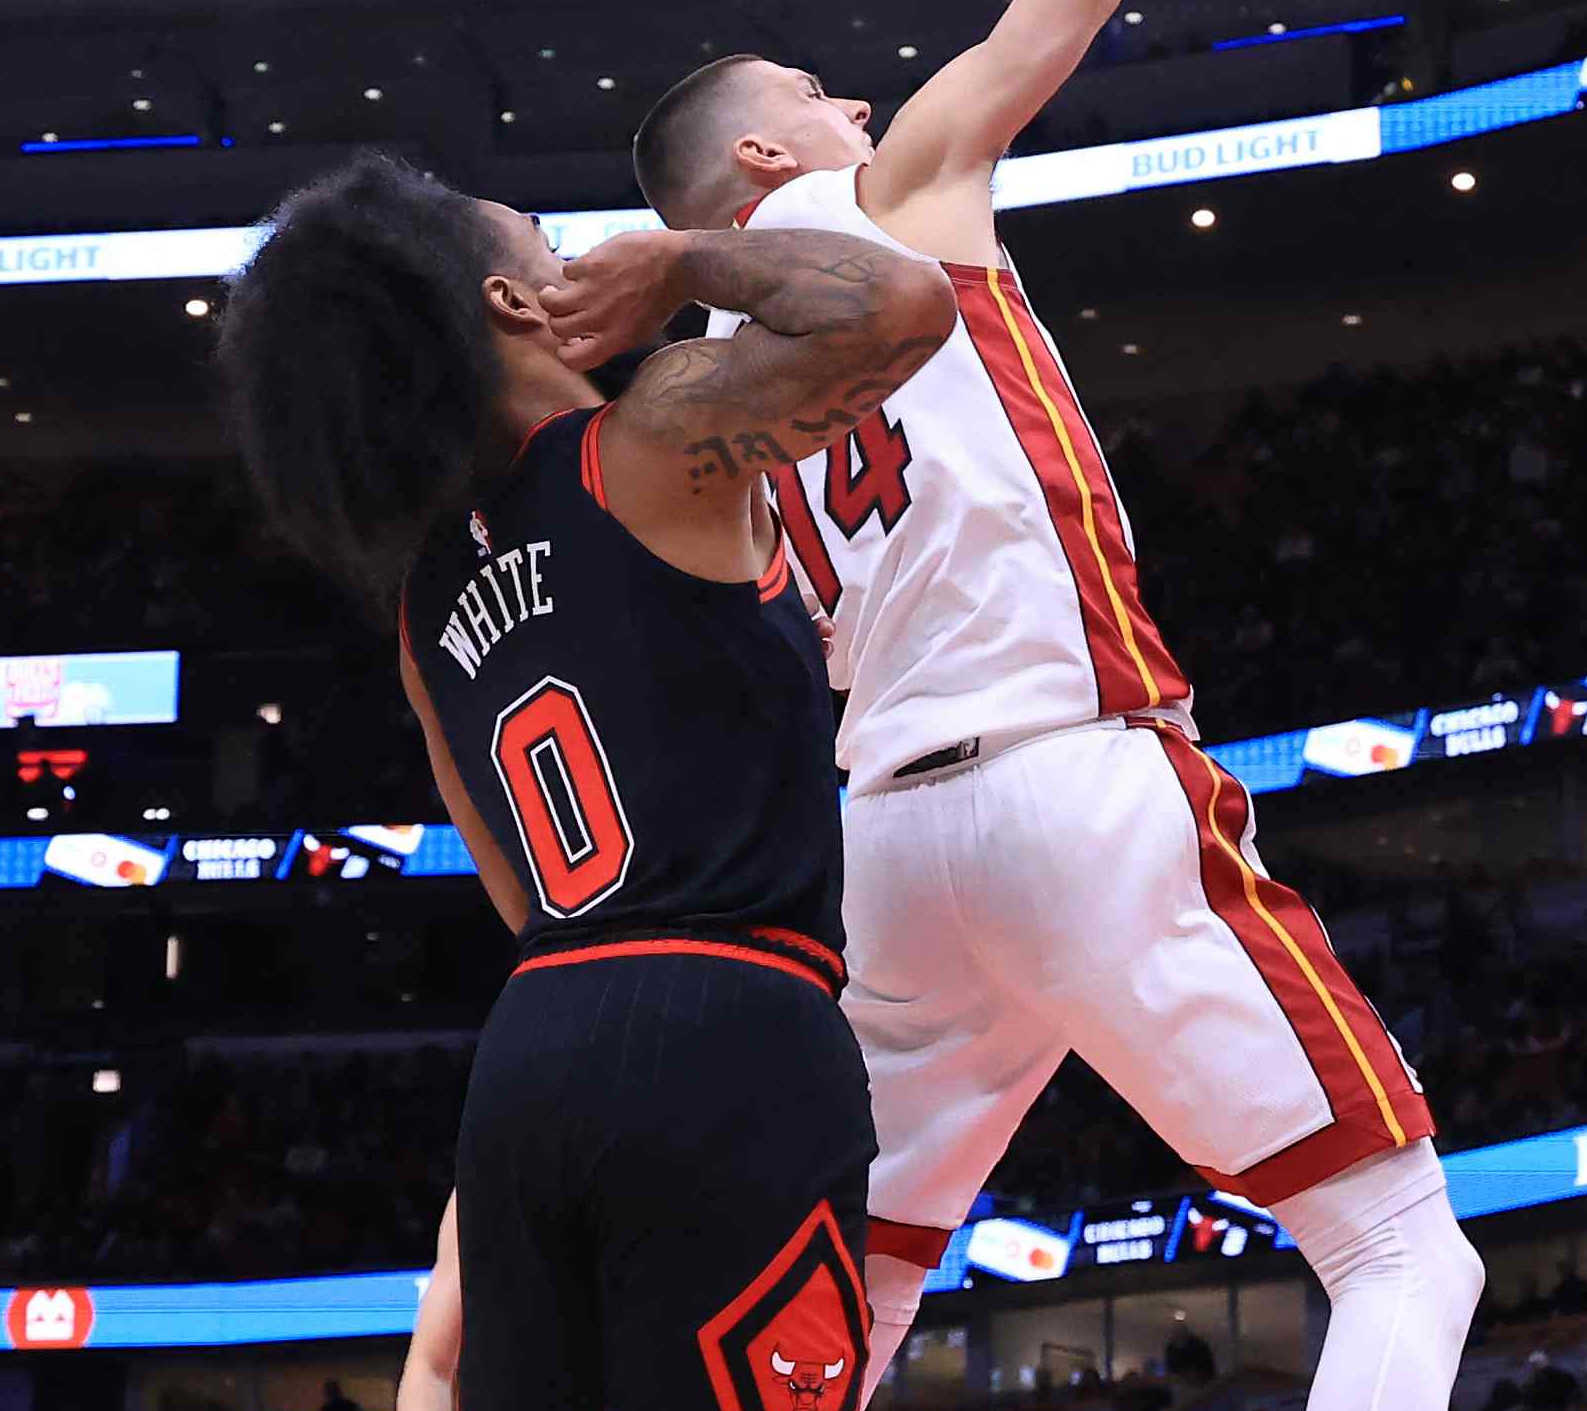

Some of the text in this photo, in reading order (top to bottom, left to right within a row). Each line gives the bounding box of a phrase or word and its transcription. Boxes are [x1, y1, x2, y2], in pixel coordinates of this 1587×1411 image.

[1131, 128, 1321, 181] BUD LIGHT
[438, 539, 555, 681] WHITE
[490, 675, 635, 920] 0
